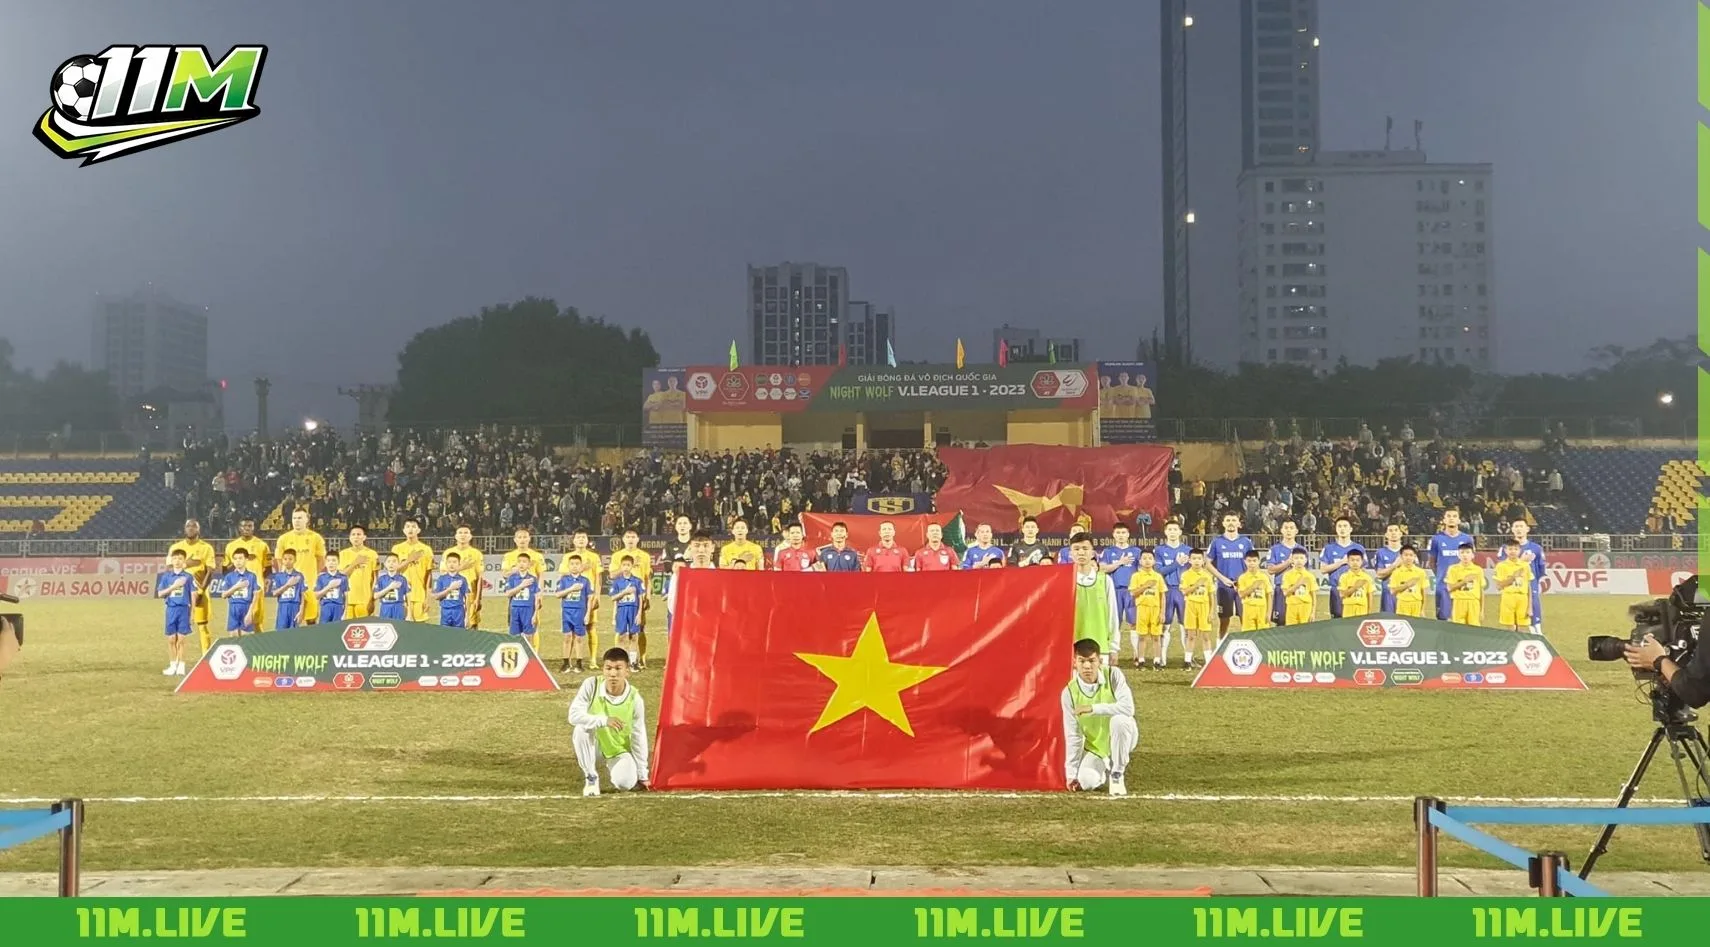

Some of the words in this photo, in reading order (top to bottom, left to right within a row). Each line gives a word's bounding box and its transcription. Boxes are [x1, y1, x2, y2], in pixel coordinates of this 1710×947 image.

[982, 373, 997, 381] GIA
[830, 386, 861, 399] NIGHT
[865, 385, 894, 399] WOLF
[898, 385, 969, 396] V.LEAGUE
[971, 385, 979, 396] 1
[989, 384, 1026, 395] 2023
[1553, 570, 1608, 588] VPF
[40, 581, 66, 596] BIA
[70, 581, 103, 596] SAO
[251, 654, 290, 673] NIGHT
[294, 654, 329, 674] WOLF
[332, 654, 418, 668] V.LEAGUE
[419, 654, 429, 668] 1
[441, 653, 486, 668] 2023
[1267, 650, 1306, 669] NIGHT
[1310, 650, 1346, 670] WOLF
[1350, 651, 1438, 665] V.LEAGUE
[1440, 651, 1451, 665] 1
[1462, 651, 1508, 665] 2023
